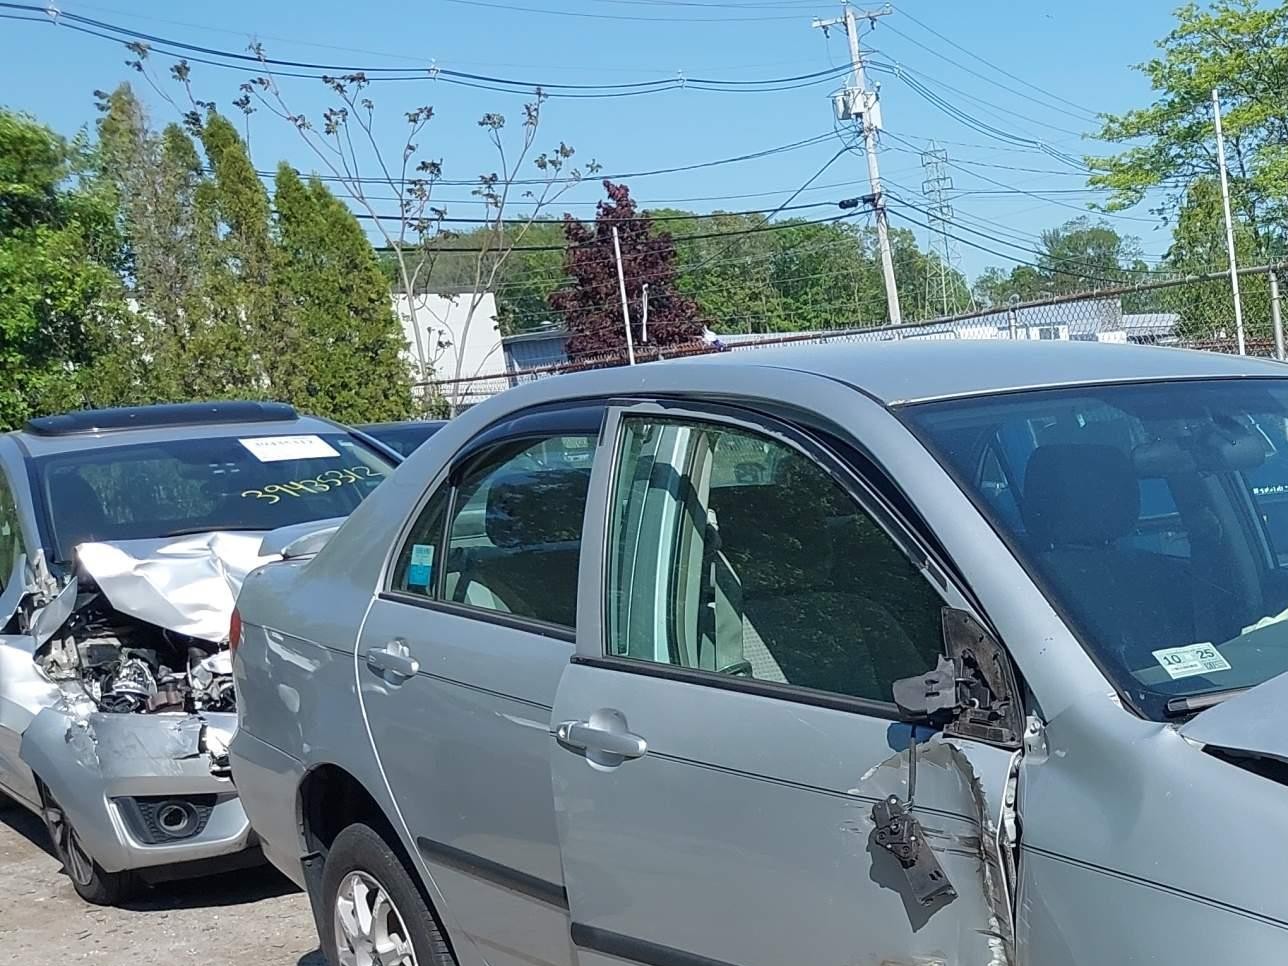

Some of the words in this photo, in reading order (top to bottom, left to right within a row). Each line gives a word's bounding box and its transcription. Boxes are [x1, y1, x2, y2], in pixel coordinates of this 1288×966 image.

[241, 466, 384, 505] 39435312
[1163, 654, 1182, 666] 10
[1196, 648, 1215, 660] 25
